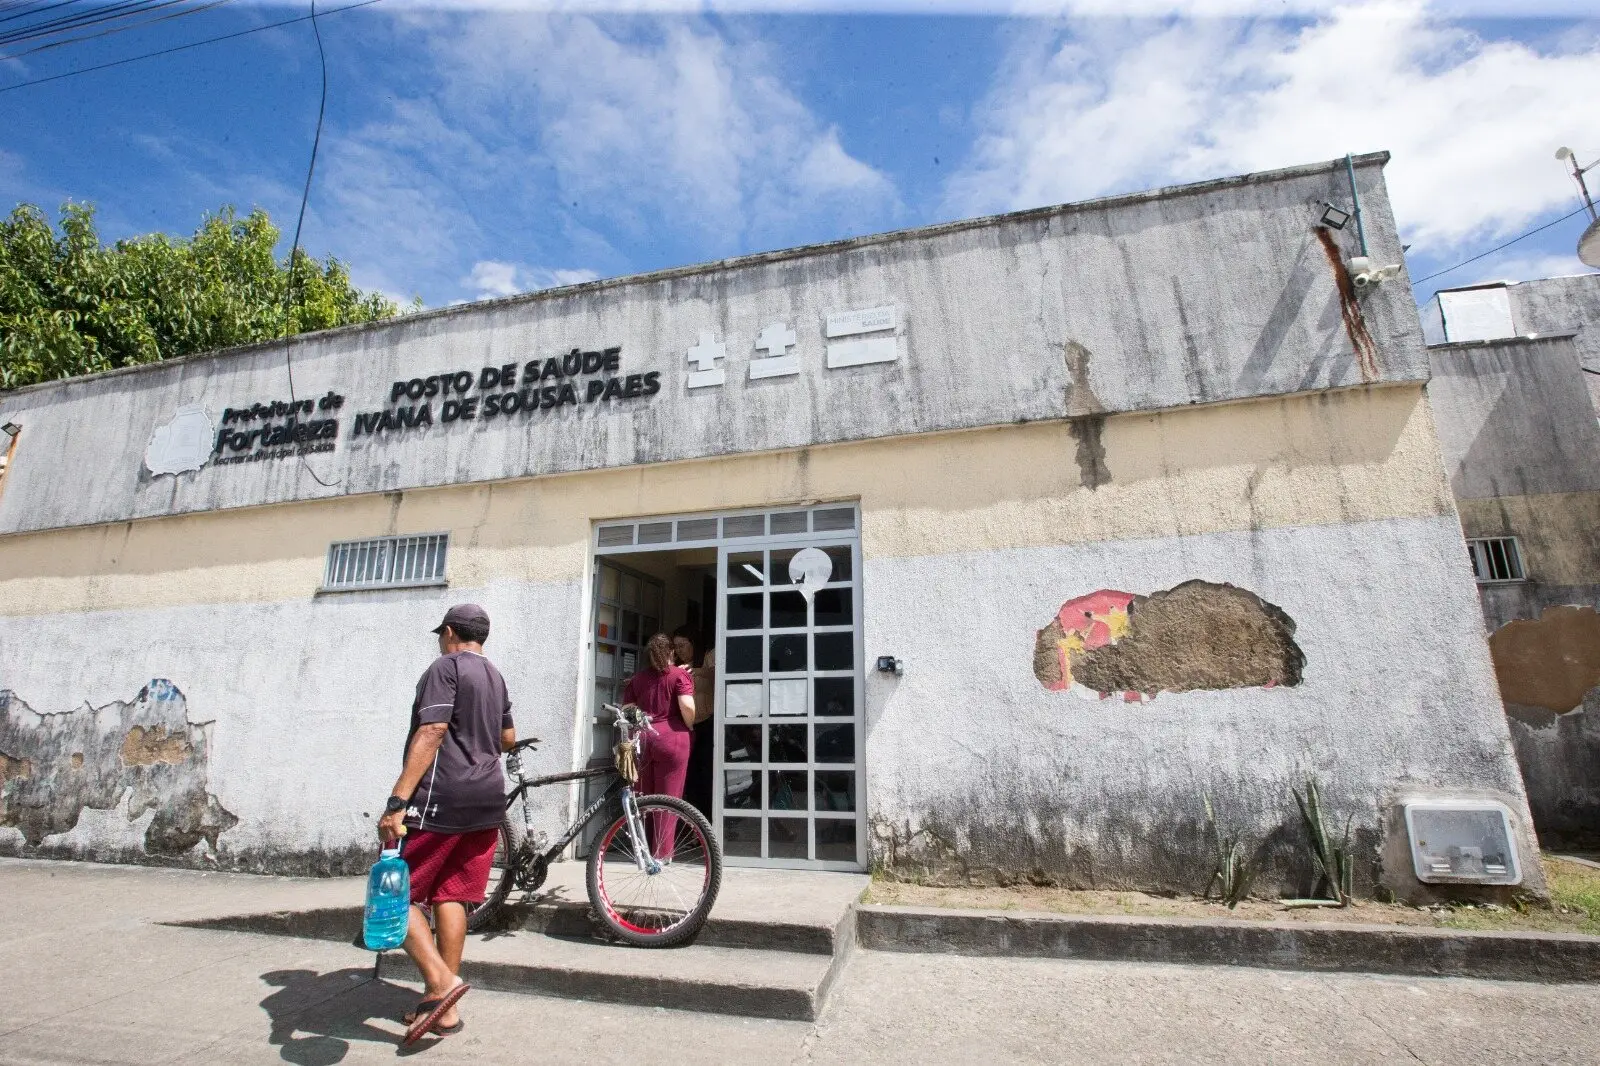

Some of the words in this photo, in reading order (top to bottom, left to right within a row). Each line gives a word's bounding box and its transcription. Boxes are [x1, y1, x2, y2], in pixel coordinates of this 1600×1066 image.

[391, 370, 473, 403] POSTO
[479, 363, 518, 390] DE
[522, 347, 622, 384] SAÚDE
[222, 399, 315, 425] Prefeitura
[318, 391, 345, 411] de
[353, 401, 434, 436] IVANA
[441, 396, 480, 423] DE
[483, 383, 577, 417] SOUSA
[586, 371, 662, 403] PAES
[216, 417, 339, 453] Fortaleza
